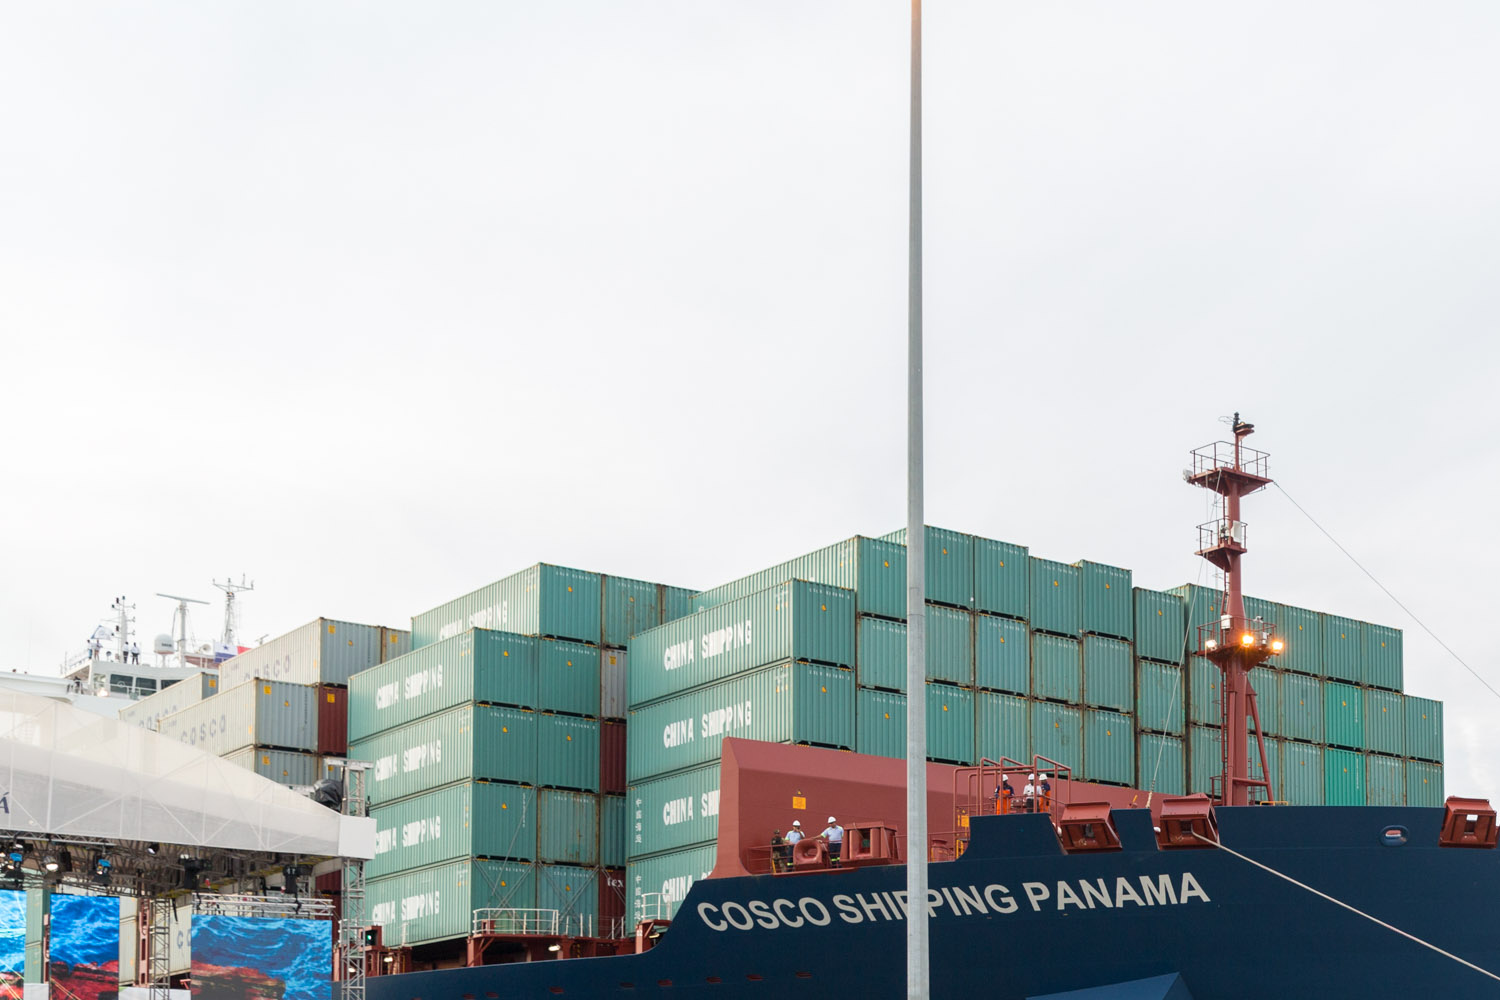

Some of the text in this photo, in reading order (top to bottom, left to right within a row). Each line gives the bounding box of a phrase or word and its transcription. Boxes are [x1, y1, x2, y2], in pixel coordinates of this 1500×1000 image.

[664, 619, 752, 671] CHINA SHIPPING
[663, 700, 752, 749] CHINA SHIPPING
[662, 796, 694, 826] CHINA
[661, 874, 694, 904] CHINA
[697, 896, 832, 932] COSCO
[1022, 872, 1211, 912] PANAMA
